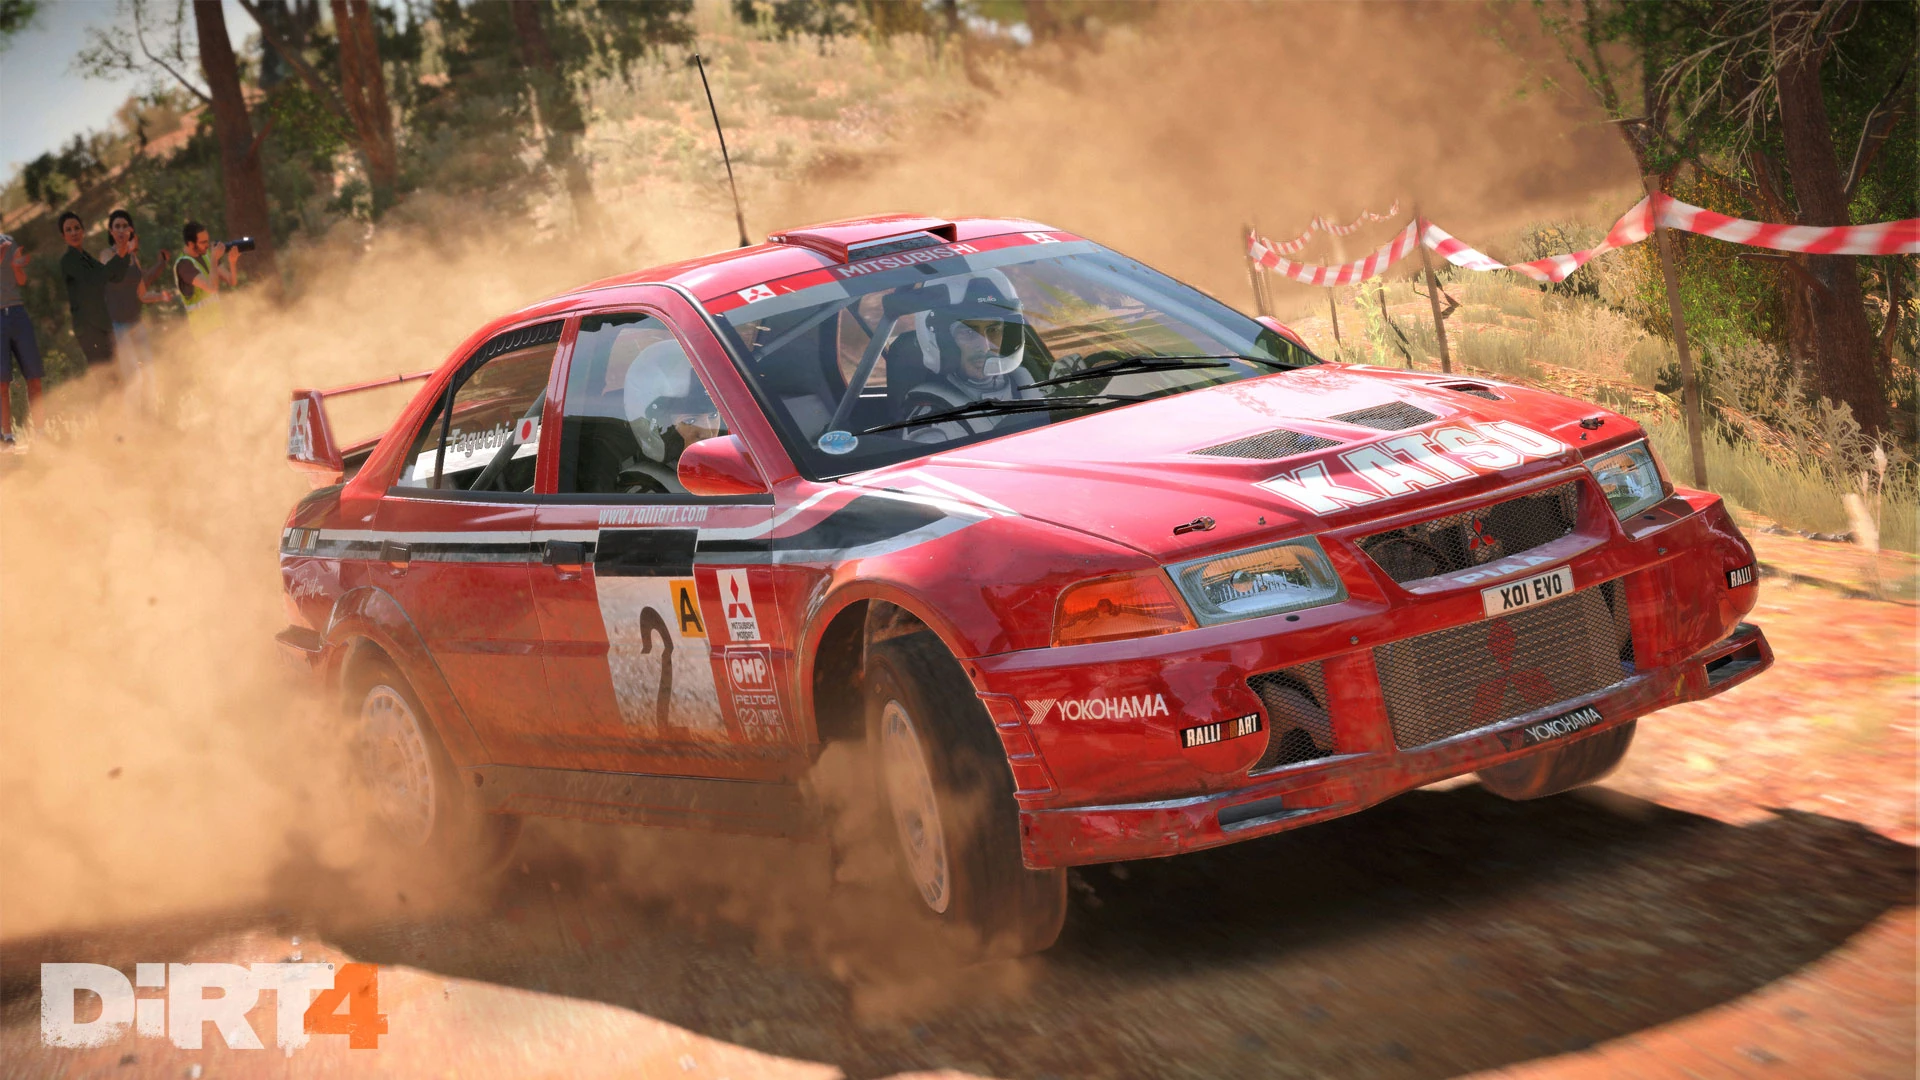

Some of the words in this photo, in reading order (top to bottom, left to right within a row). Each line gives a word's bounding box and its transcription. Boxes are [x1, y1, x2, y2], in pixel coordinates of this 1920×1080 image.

[837, 243, 980, 278] MITSUBISHI
[450, 421, 510, 458] Taguchi
[1251, 420, 1566, 517] KATSU
[598, 505, 709, 525] www.ralliart.com
[1451, 555, 1558, 584] PIAA
[1730, 566, 1752, 588] RALLI
[1533, 573, 1562, 601] EVO
[679, 587, 704, 633] A
[731, 658, 766, 684] OMP
[735, 694, 777, 705] PELTOR
[1056, 693, 1170, 721] YOKOHAMA
[1525, 707, 1603, 742] YOKOHAMA
